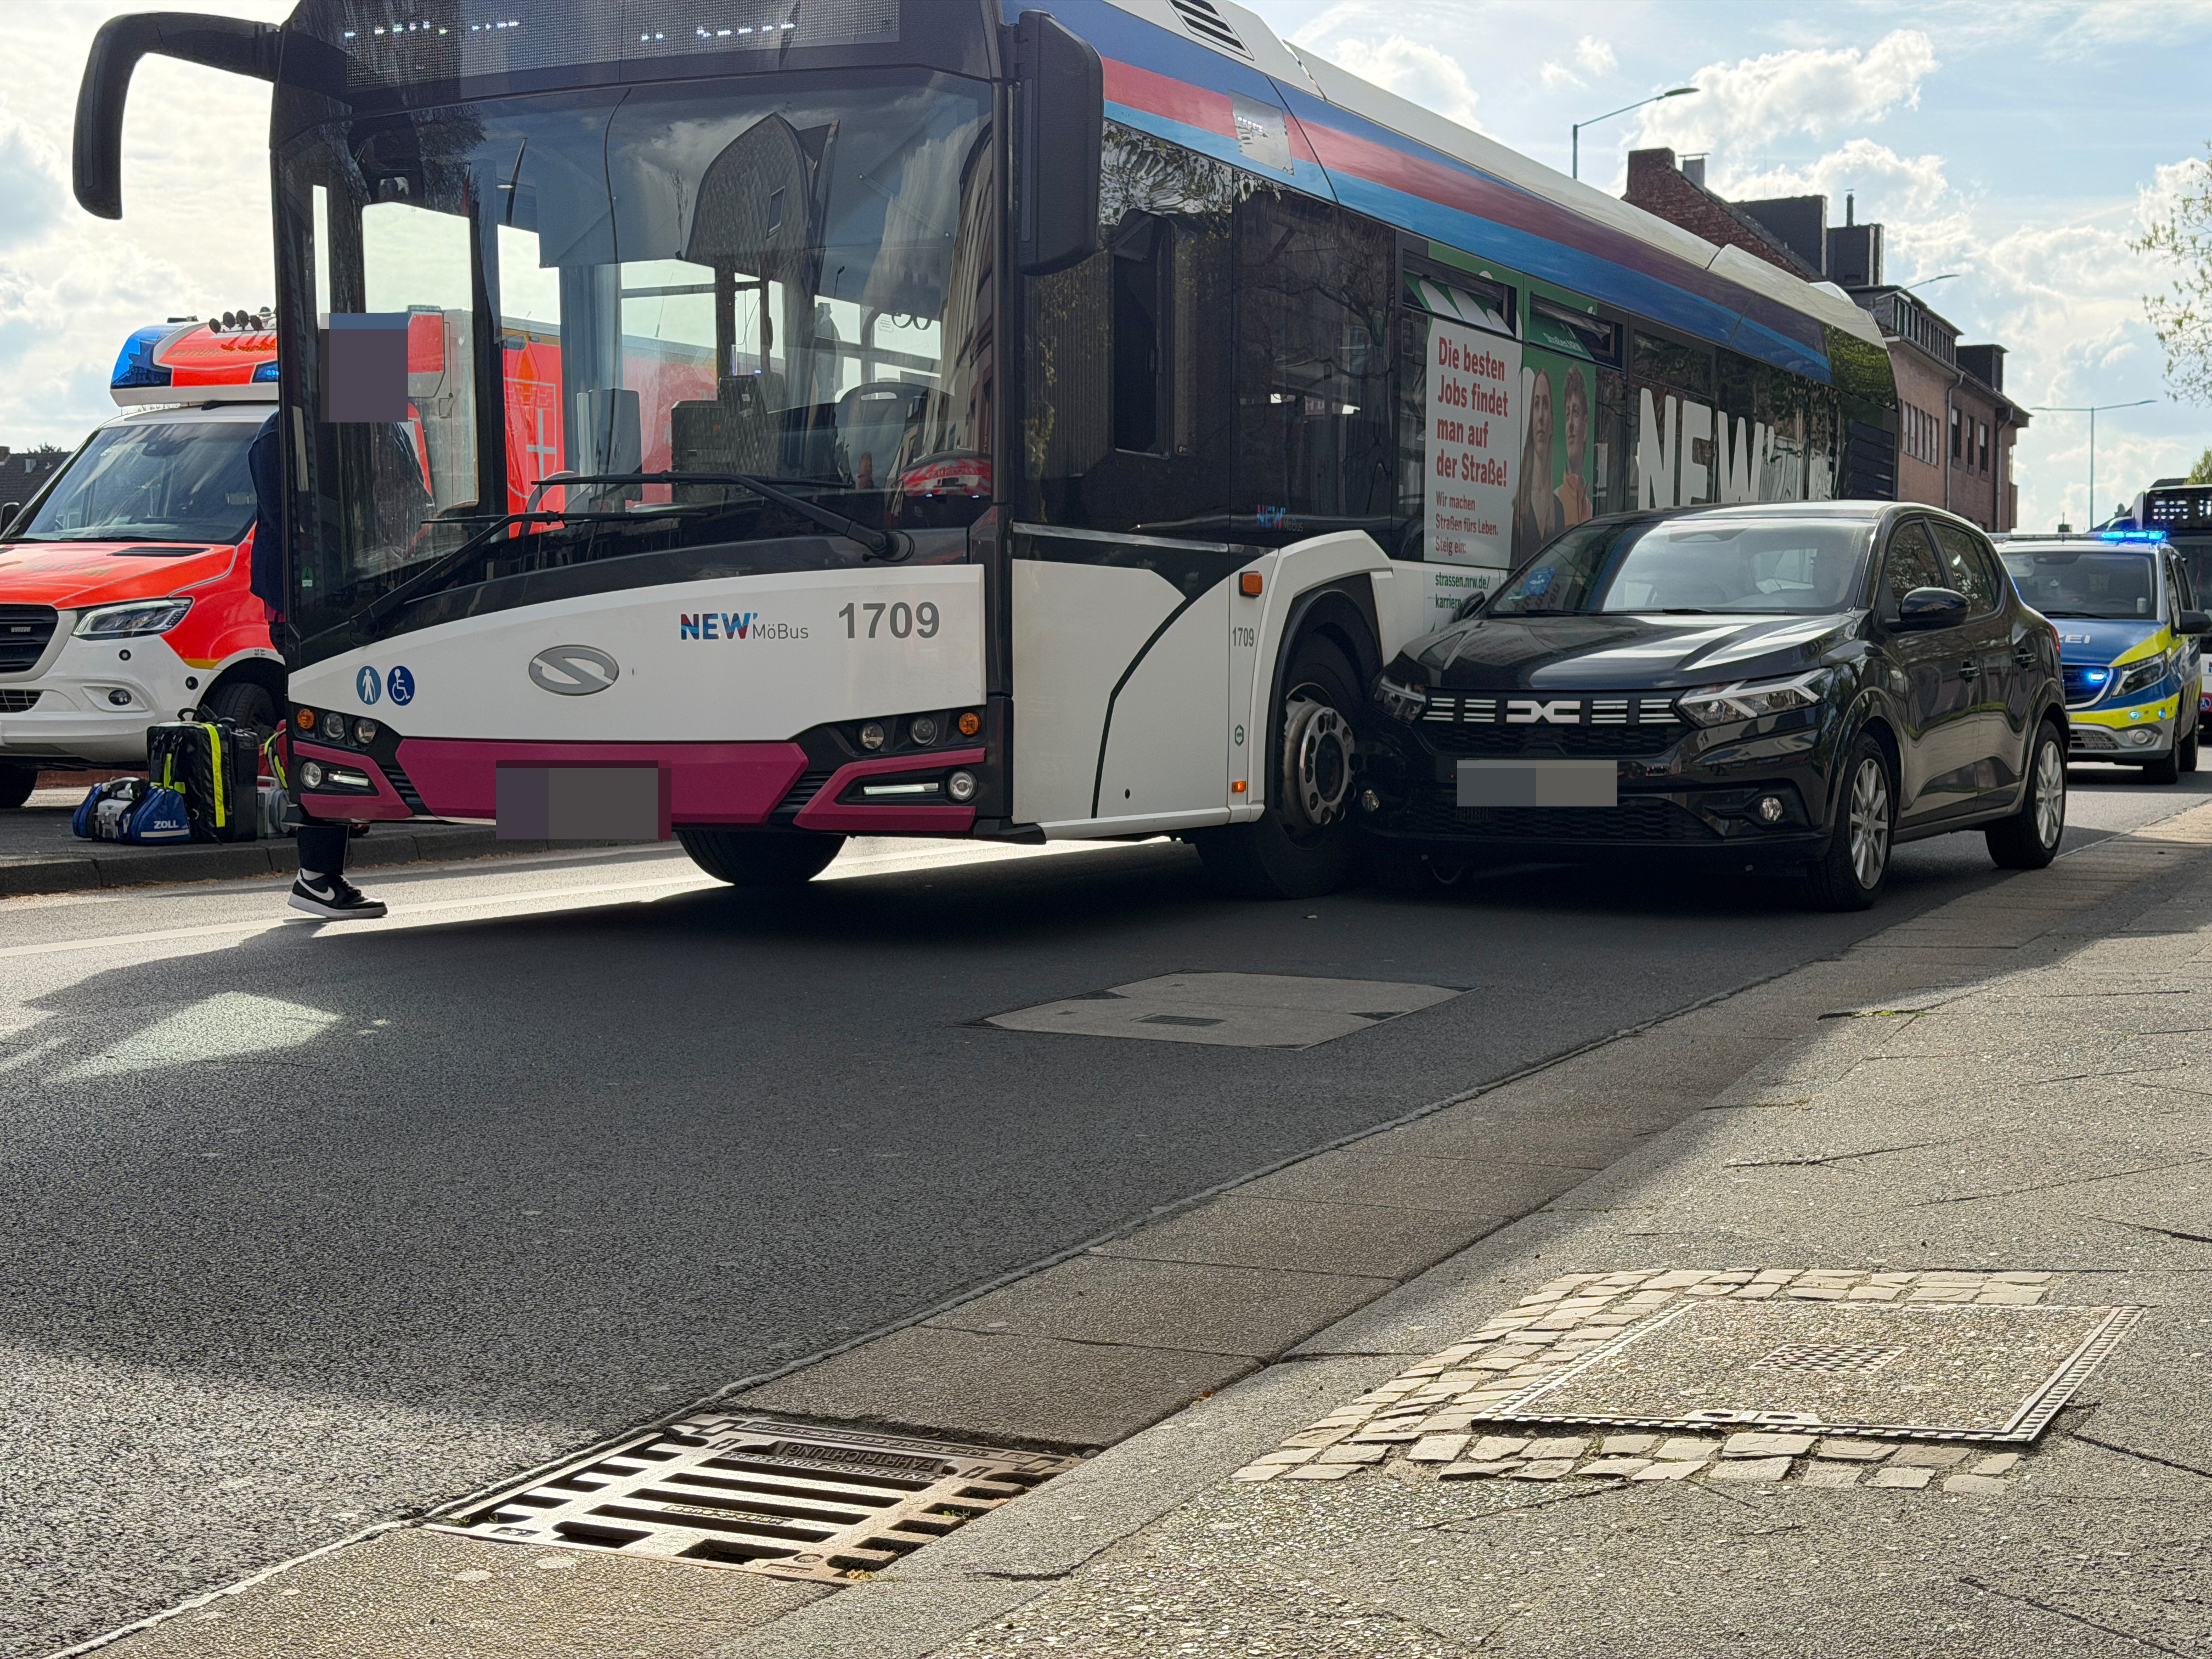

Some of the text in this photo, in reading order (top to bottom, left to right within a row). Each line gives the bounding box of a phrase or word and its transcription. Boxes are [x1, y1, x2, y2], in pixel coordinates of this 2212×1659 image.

[1438, 336, 1505, 381] Die besten
[1437, 374, 1508, 417] Jobs findet
[1437, 418, 1488, 448] man auf
[1436, 448, 1507, 487] der Straße!
[1436, 490, 1475, 511] Wir machen
[1435, 513, 1498, 535] Straßen fürs Leben.
[1435, 535, 1466, 556] Steig ein:
[1435, 571, 1491, 590] strassen.nrw.de/
[1435, 594, 1462, 610] karriere
[838, 601, 940, 640] 1709
[753, 623, 809, 640] MöBus
[1232, 627, 1254, 647] 1709
[154, 820, 179, 829] ZOLL
[788, 1444, 936, 1470] FAHRTRICHTUNG
